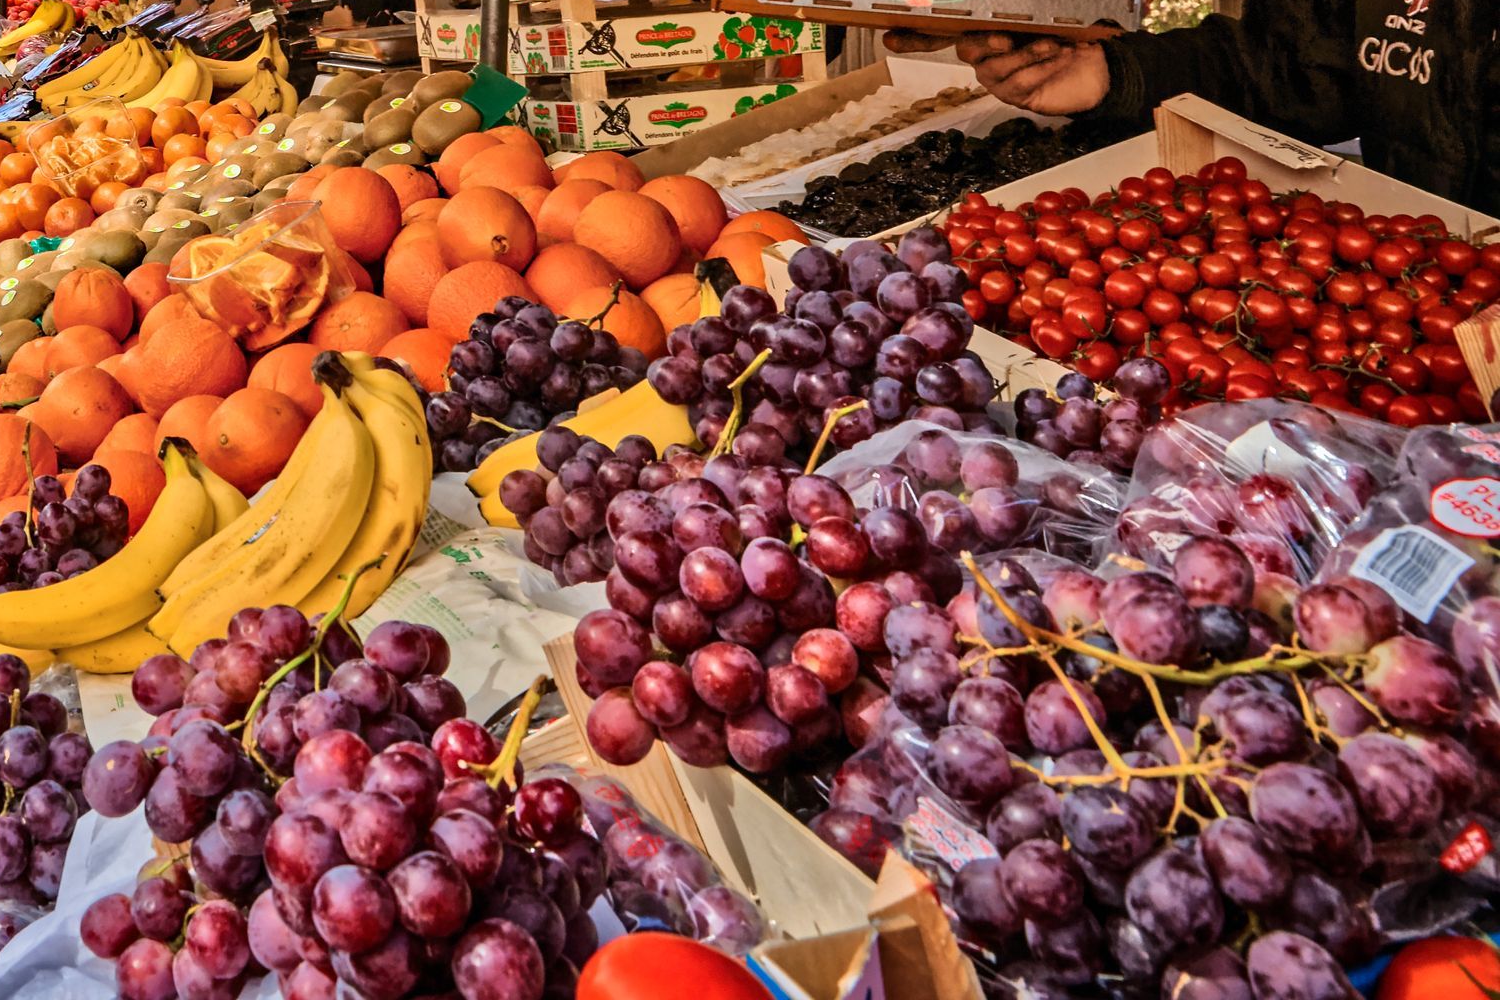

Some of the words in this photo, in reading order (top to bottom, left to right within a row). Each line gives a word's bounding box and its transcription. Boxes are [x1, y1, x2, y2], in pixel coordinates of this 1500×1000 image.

[664, 30, 693, 38] BRETAGNE
[676, 110, 705, 118] BRETAGNE
[1467, 485, 1500, 510] PL
